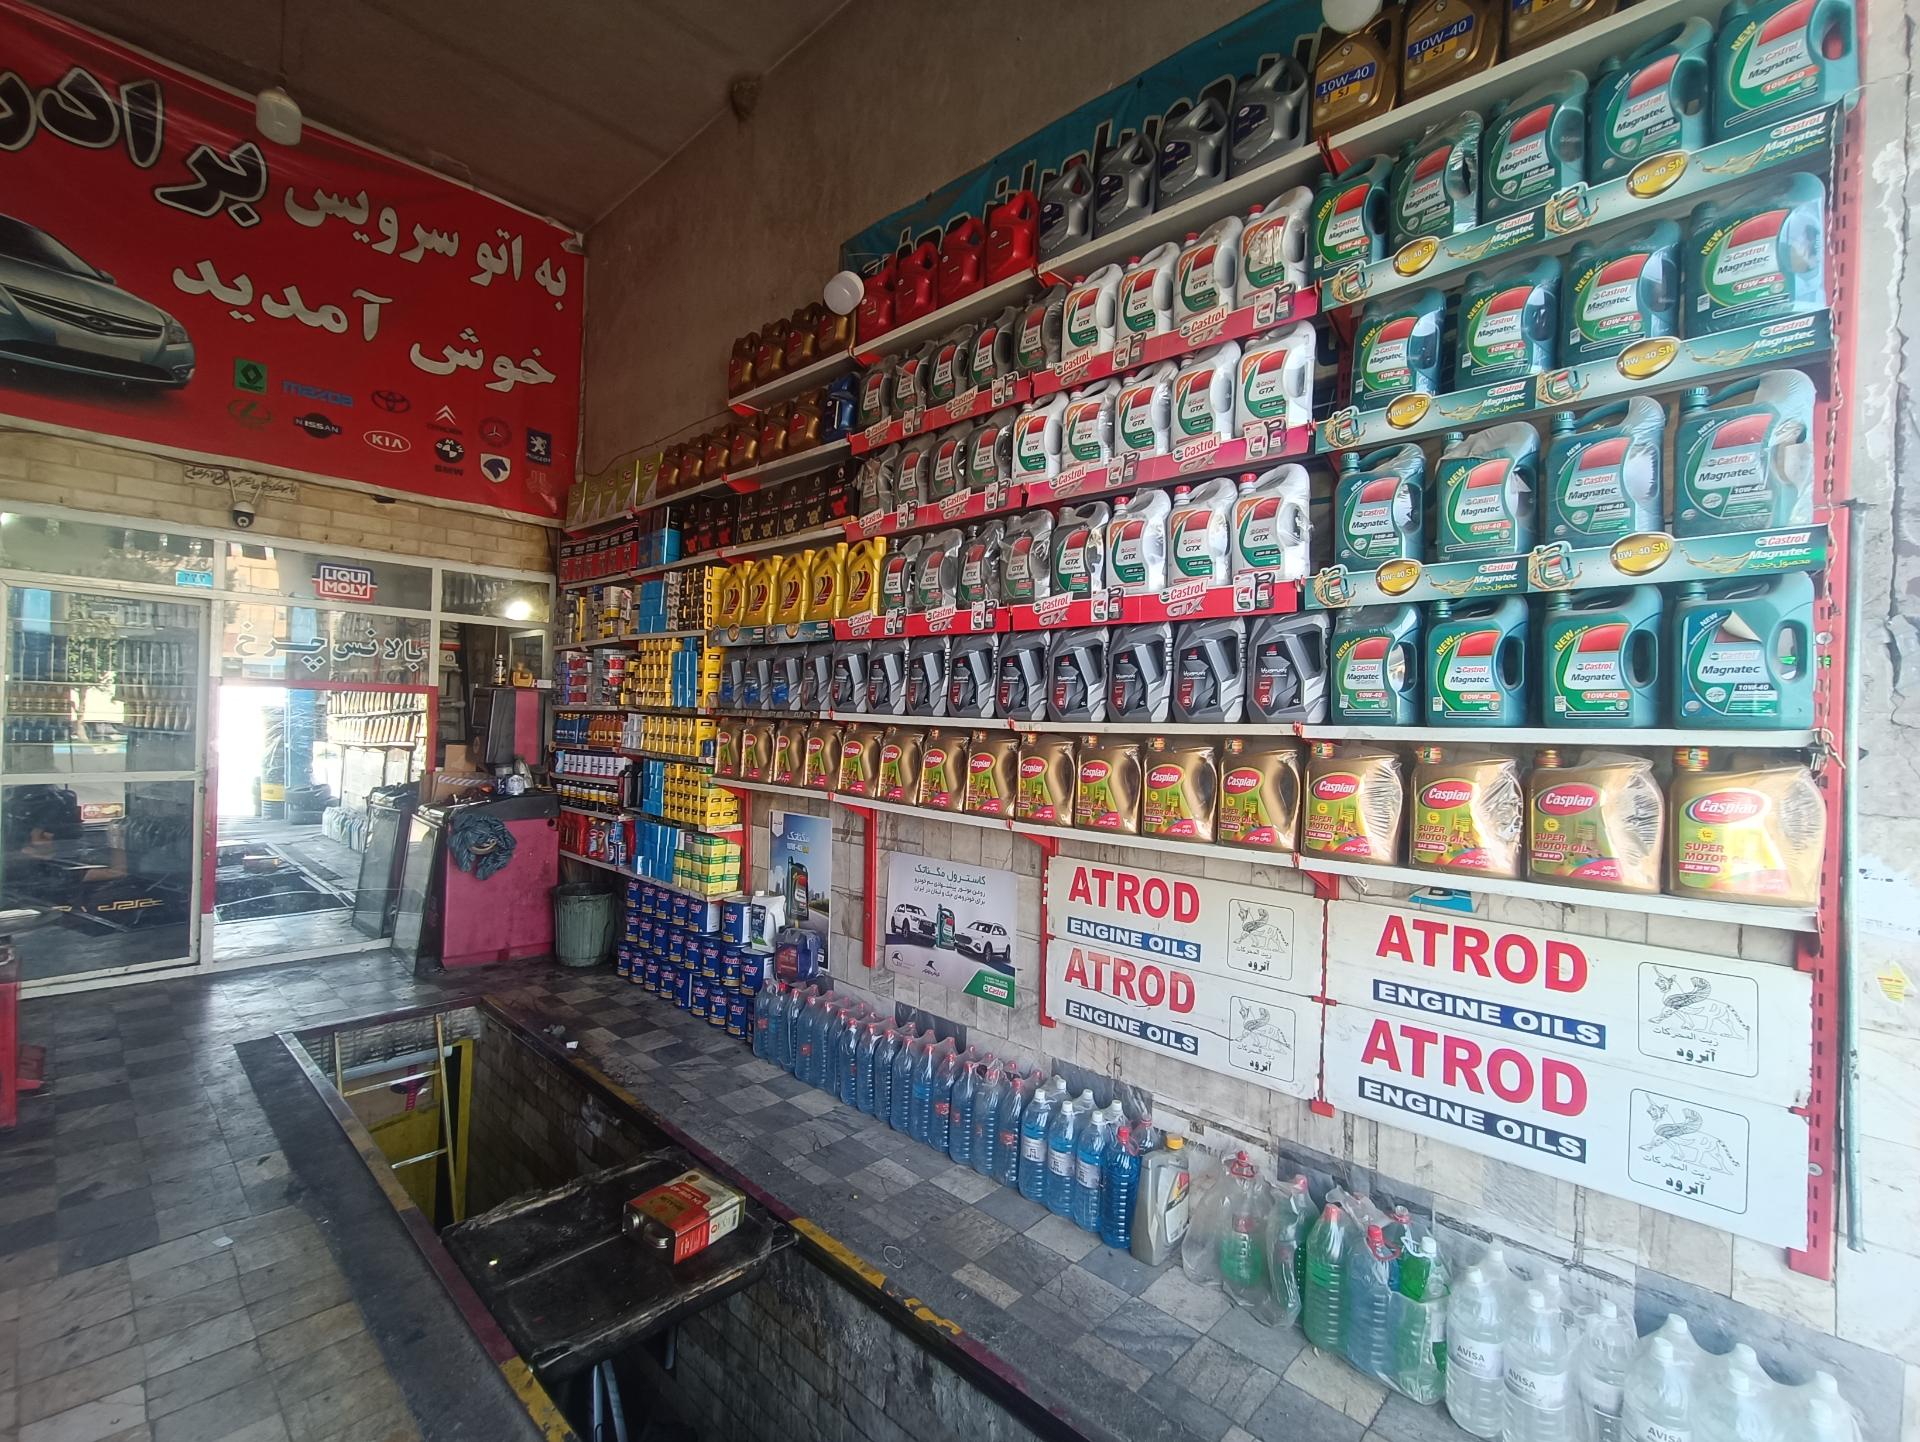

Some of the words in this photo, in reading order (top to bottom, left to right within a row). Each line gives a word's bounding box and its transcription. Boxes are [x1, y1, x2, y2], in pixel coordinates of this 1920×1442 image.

[1412, 19, 1468, 56] 10W-40
[1731, 21, 1757, 51] NEW
[1747, 52, 1803, 80] Magnatec
[1320, 65, 1370, 95] 10W-40
[1616, 105, 1667, 133] Magnatec
[1781, 114, 1824, 135] Castrol
[1764, 126, 1826, 151] Magnatec
[1499, 151, 1544, 174] Magnatec
[1403, 190, 1441, 212] Magnatec
[1317, 199, 1334, 221] NEW
[283, 186, 460, 265] سرویس
[1503, 213, 1533, 229] Castrol
[1328, 225, 1362, 241] Magnatec
[1490, 223, 1535, 243] Magnatec
[1701, 229, 1725, 257] NEW
[470, 227, 523, 287] اتو
[1716, 255, 1770, 276] Magnatec
[534, 259, 568, 312] به
[1574, 268, 1595, 293] NEW
[172, 258, 394, 342] آمدید
[1585, 295, 1632, 313] Magnatec
[1467, 298, 1485, 320] NEW
[1191, 308, 1225, 333] Castrol
[1771, 318, 1811, 336] Castrol
[1361, 327, 1377, 348] NEW
[1477, 323, 1517, 339] Magnatec
[1752, 330, 1816, 350] Magnatec
[408, 328, 558, 393] خوش
[1063, 353, 1090, 372] Castrol
[1494, 383, 1524, 396] Castrol
[1481, 392, 1526, 409] Magnatec
[295, 417, 340, 434] NISSAN
[371, 433, 404, 450] KIA
[1184, 437, 1217, 459] Castrol
[1058, 467, 1085, 485] Castrol
[1446, 466, 1467, 488] NEW
[1583, 474, 1614, 486] Castrol
[1697, 467, 1758, 483] Magnatec
[946, 490, 969, 508] Castrol
[1470, 495, 1497, 506] Castrol
[1567, 486, 1618, 501] Magnatec
[864, 511, 882, 526] Castrol
[1362, 507, 1386, 518] Castrol
[1460, 504, 1501, 518] Magnatec
[1351, 518, 1389, 530] Magnatec
[1767, 534, 1808, 546] Castrol
[1749, 547, 1812, 561] Magnatec
[324, 568, 367, 583] LIQUI
[1487, 563, 1515, 572] Castrol
[1475, 573, 1518, 584] Magnatec
[323, 580, 369, 596] MOLY
[1170, 584, 1204, 600] Castrol
[1041, 596, 1069, 611] Castrol
[1167, 597, 1204, 617] GTX
[852, 613, 872, 626] Castrol
[932, 608, 955, 621] Castrol
[1039, 608, 1068, 626] GTX
[1699, 611, 1719, 627] NEW
[852, 624, 870, 637] GTX
[929, 620, 953, 634] GTX
[234, 619, 328, 673] چرخ
[1436, 635, 1455, 656] NEW
[1554, 629, 1575, 652] NEW
[331, 627, 428, 673] بالانس
[1335, 640, 1351, 660] NEW
[1356, 664, 1377, 672] Castrol
[1461, 666, 1487, 674] Castrol
[1584, 662, 1612, 671] Castrol
[1701, 664, 1761, 677] Magnatec
[1346, 672, 1380, 682] Magnatec
[1450, 675, 1491, 685] Magnatec
[1571, 673, 1617, 683] Magnatec
[1463, 692, 1492, 701] 10W-40
[1586, 691, 1619, 700] 10W-40
[924, 754, 942, 764] Caspian
[970, 758, 991, 769] Caspian
[1021, 763, 1043, 774] Caspian
[1081, 767, 1106, 778] Caspian
[1151, 772, 1179, 783] Caspian
[1227, 776, 1257, 787] Caspian
[1318, 781, 1356, 794] Caspian
[1428, 787, 1471, 801] Caspian
[1545, 792, 1593, 807] Caspian
[1699, 799, 1759, 815] Caspian
[1308, 821, 1334, 831] MOTOR
[1309, 814, 1333, 823] SUPER
[1418, 824, 1445, 834] SUPER
[1535, 832, 1566, 842] SUPER
[1417, 832, 1448, 843] MOTOR
[1535, 841, 1569, 852] MOTOR
[1684, 842, 1725, 853] SUPER
[1684, 852, 1728, 863] MOTOR
[914, 864, 946, 878] مگناتک
[946, 870, 986, 885] کاسترول
[1068, 866, 1201, 924] ATROD
[1070, 918, 1143, 947] ENGINE
[1148, 936, 1199, 960] OILS
[1376, 914, 1590, 994] ATROD
[1247, 960, 1270, 972] آترود
[1064, 948, 1197, 1014] ATROD
[988, 987, 1007, 998] Castrol
[1377, 981, 1502, 1026] ENGINE
[1511, 1010, 1602, 1045] OILS
[1068, 1001, 1140, 1036] ENGINE
[1146, 1024, 1197, 1053] OILS
[1676, 1047, 1716, 1064] آترود
[1249, 1060, 1272, 1072] آترود
[1360, 1017, 1589, 1118] ATROD
[1362, 1080, 1486, 1132] ENGINE
[1495, 1118, 1583, 1160] OILS
[1665, 1177, 1705, 1196] آترود
[1456, 1345, 1486, 1363] AVISA
[1508, 1368, 1536, 1390] AVISA
